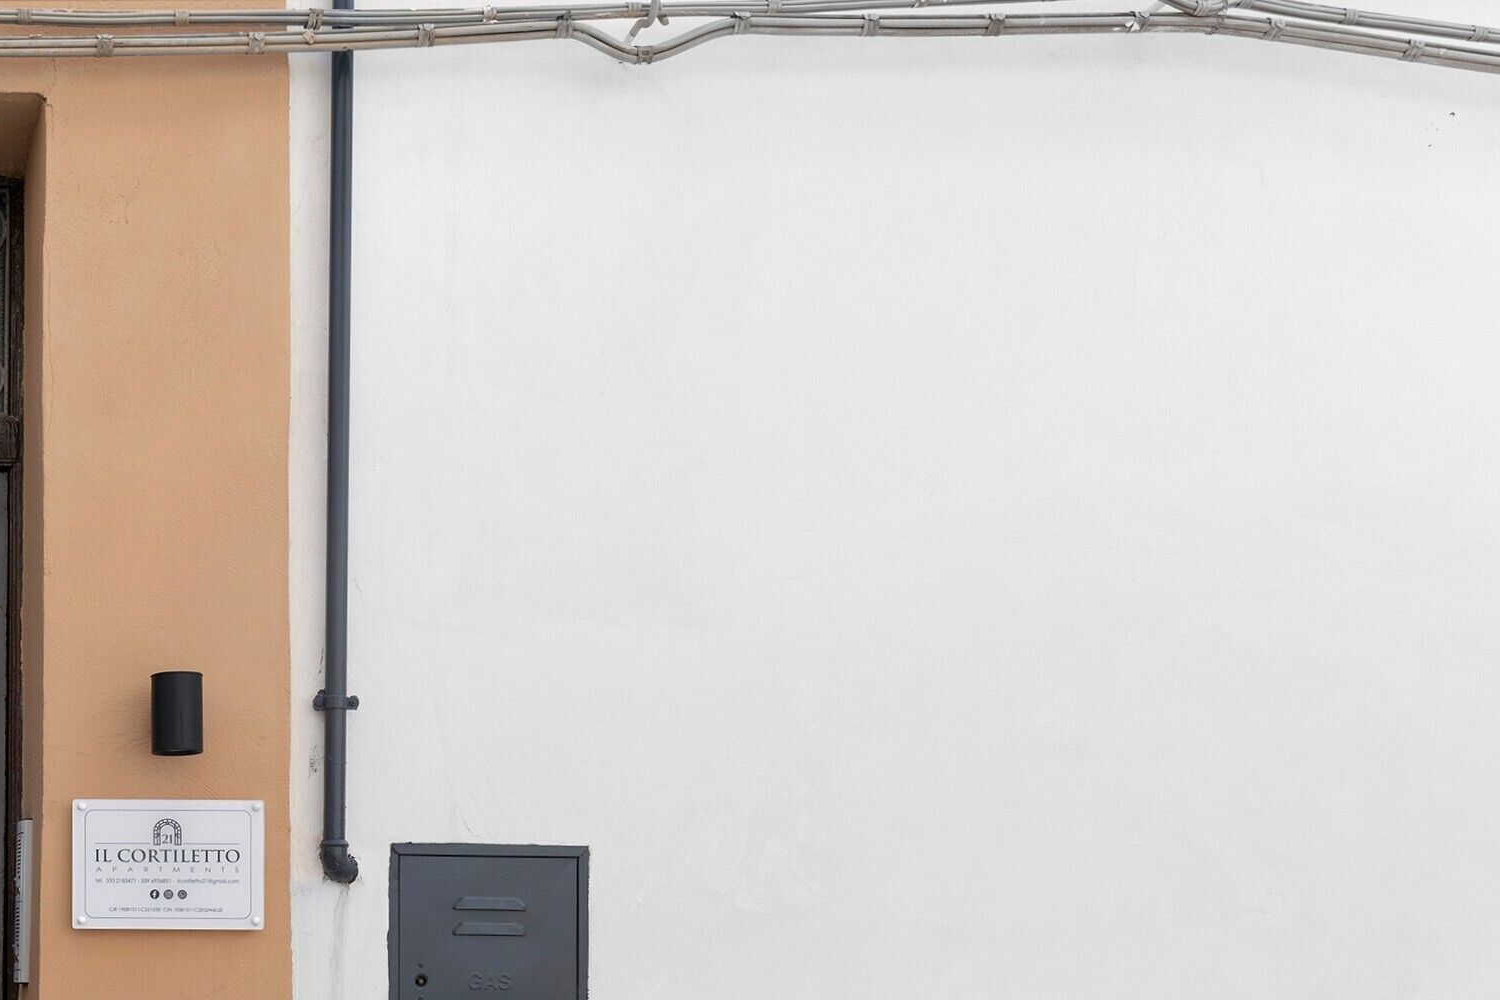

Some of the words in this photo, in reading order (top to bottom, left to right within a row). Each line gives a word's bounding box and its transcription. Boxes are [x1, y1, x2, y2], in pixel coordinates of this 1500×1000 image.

[161, 834, 173, 844] 21
[95, 848, 112, 863] IL
[117, 848, 241, 863] CORTILETTO
[468, 973, 512, 991] GAS
